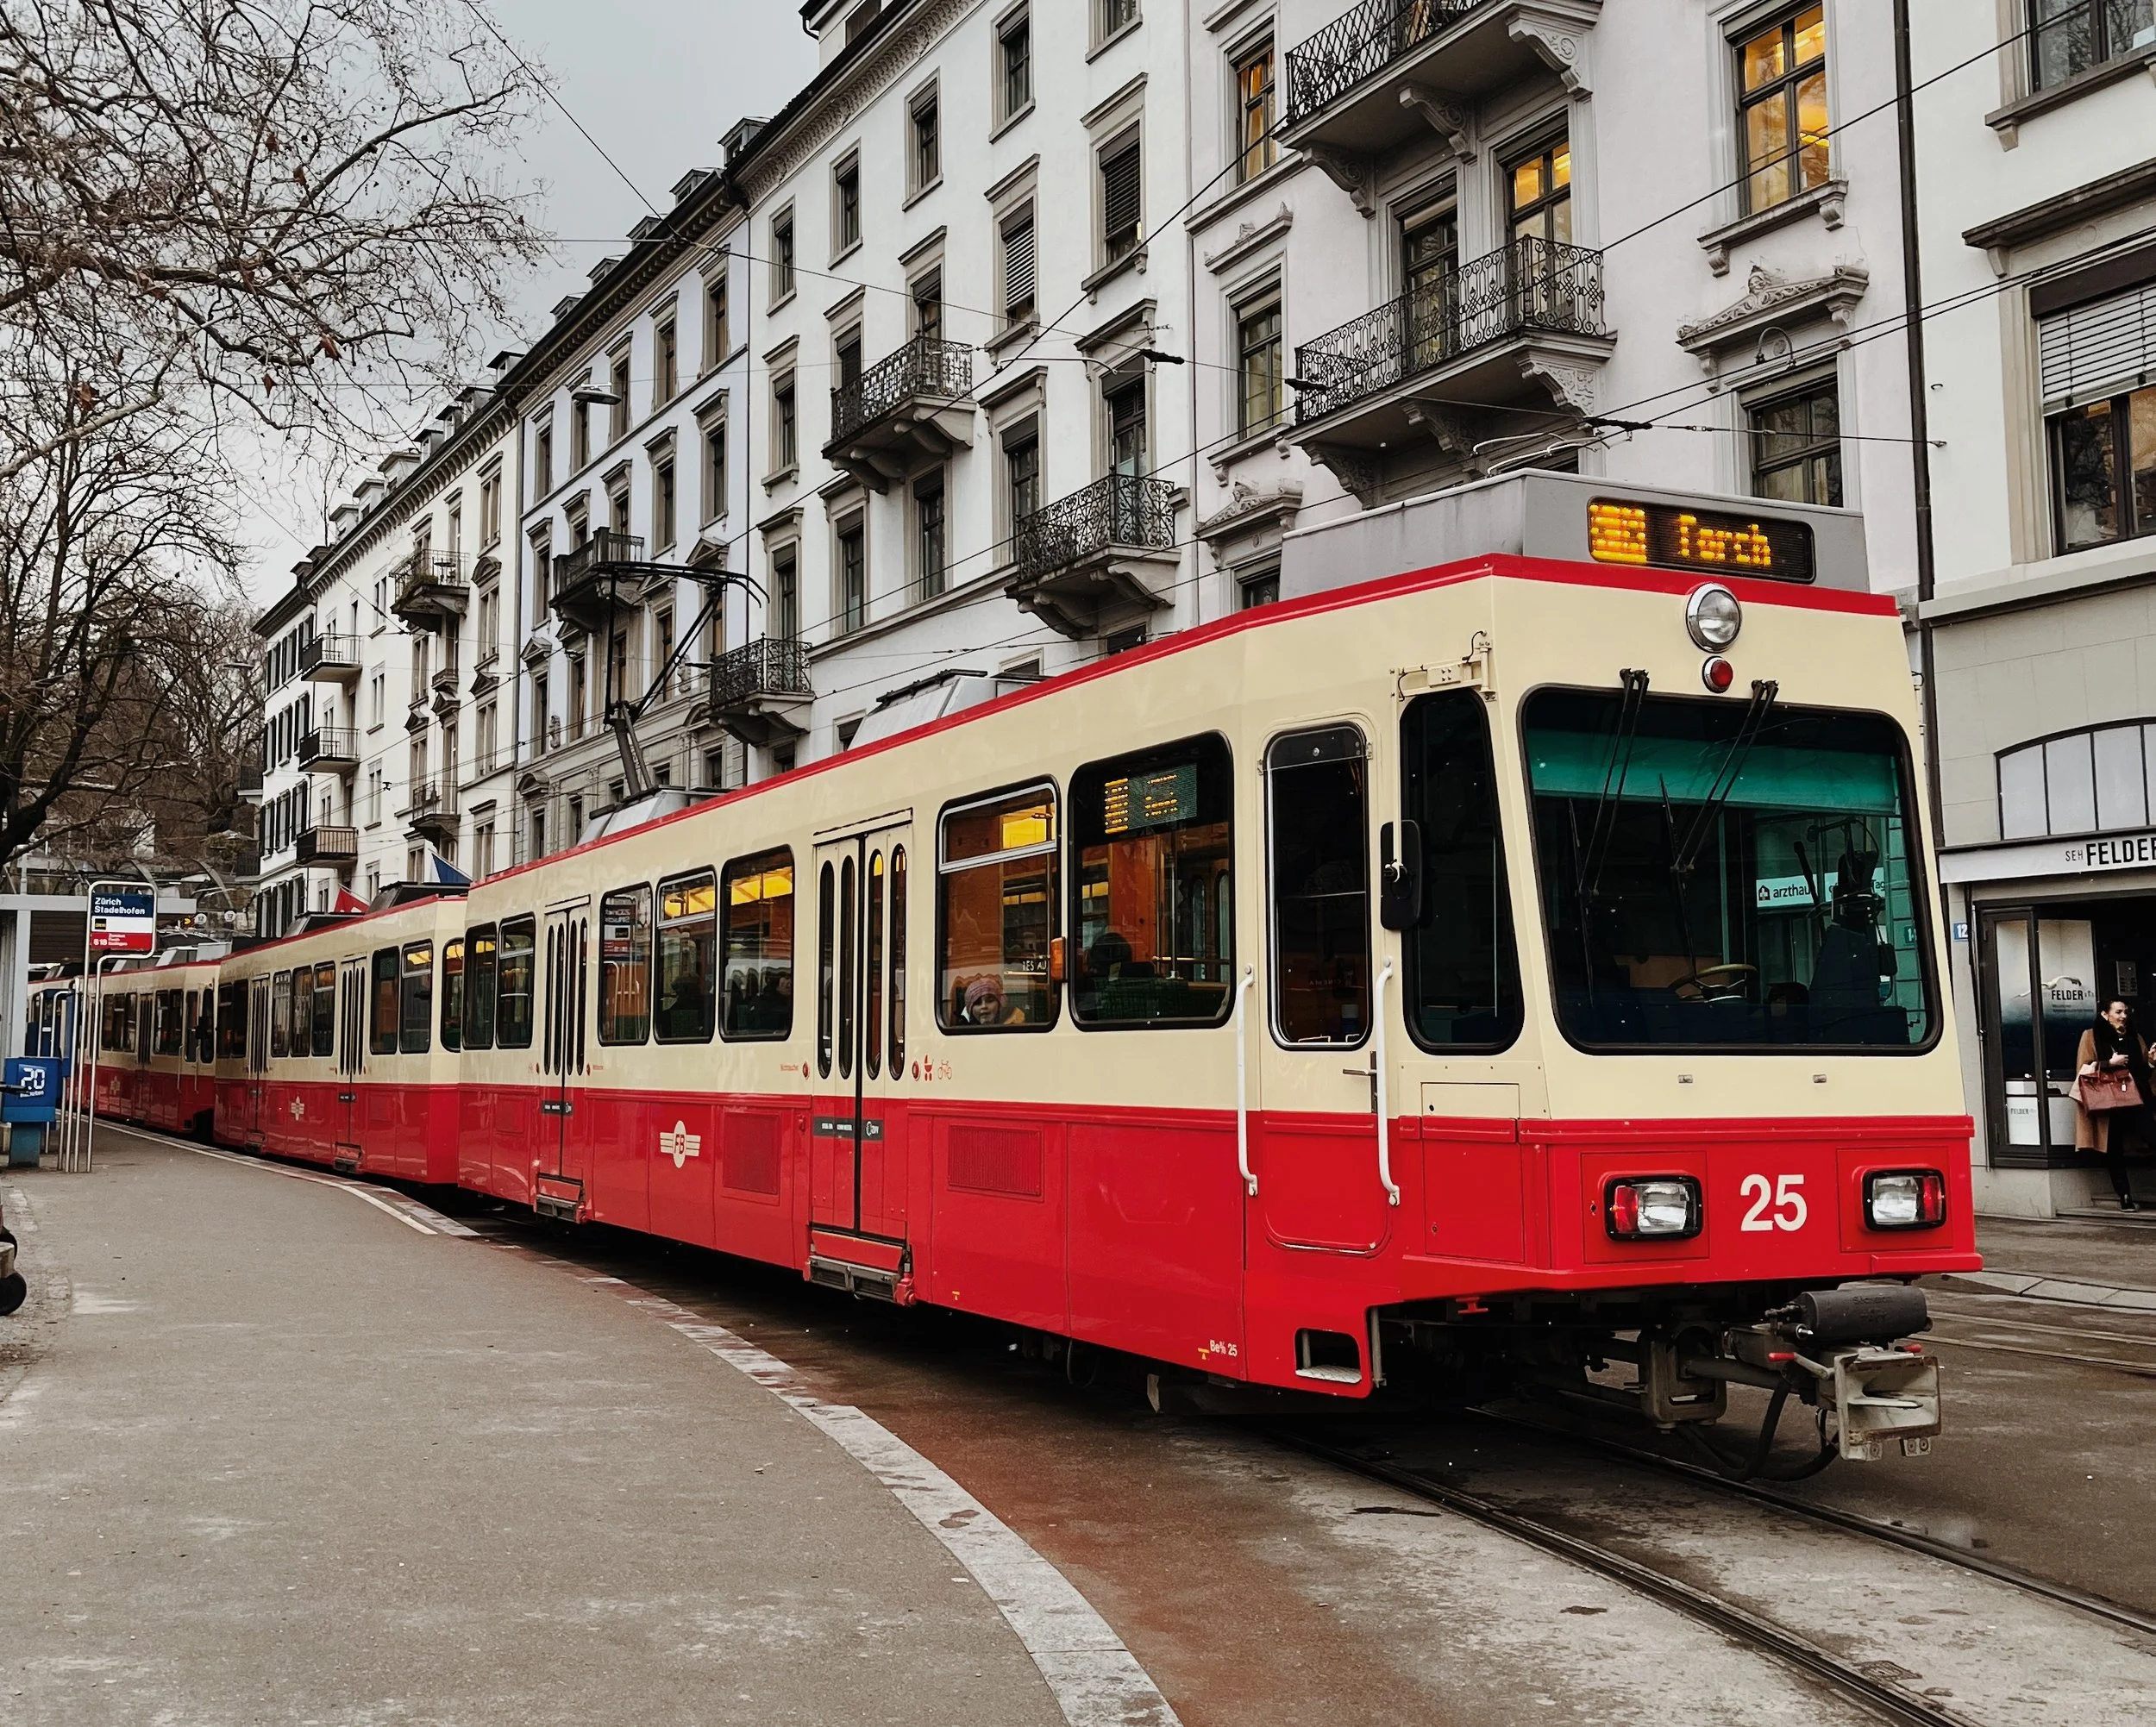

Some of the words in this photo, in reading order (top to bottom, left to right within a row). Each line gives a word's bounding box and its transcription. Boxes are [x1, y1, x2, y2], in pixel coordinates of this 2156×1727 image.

[2065, 850, 2084, 861] SEH
[1772, 883, 1816, 898] arzthau
[95, 897, 122, 905] Zürich
[94, 905, 145, 914] Stadelhofen
[1957, 923, 1968, 938] 12
[2052, 990, 2084, 1000] FELDER
[1740, 1173, 1808, 1231] 25
[1227, 1342, 1238, 1357] 25
